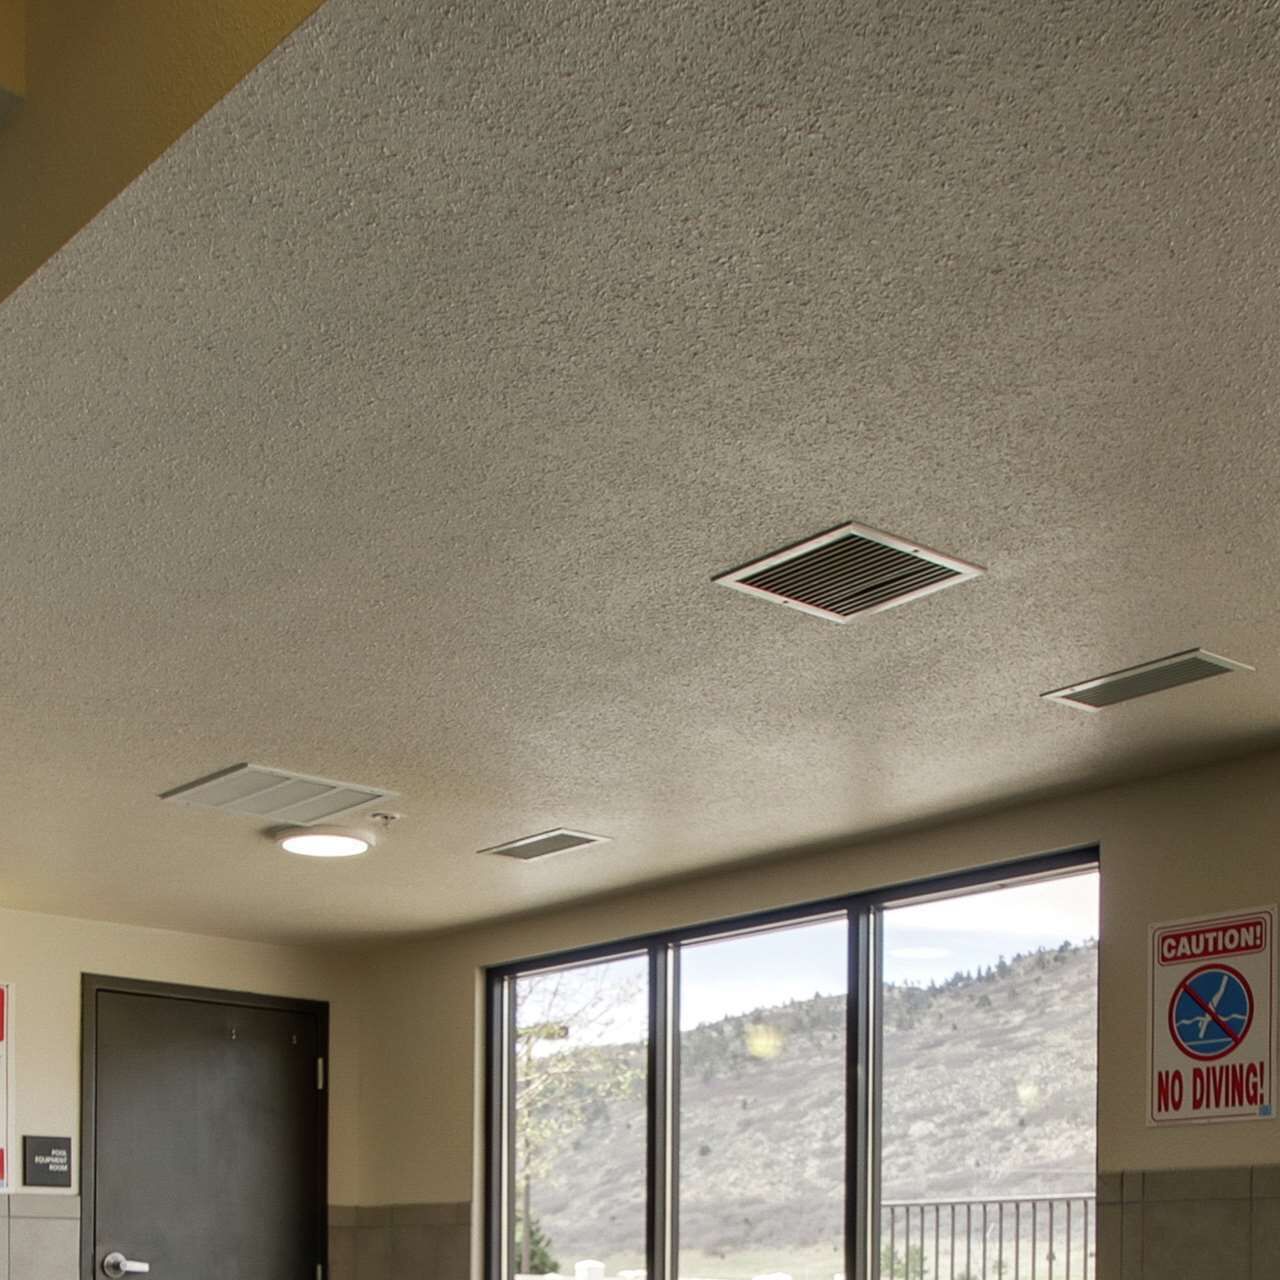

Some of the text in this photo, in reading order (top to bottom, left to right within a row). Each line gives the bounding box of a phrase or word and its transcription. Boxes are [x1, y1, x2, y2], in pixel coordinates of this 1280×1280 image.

[1163, 926, 1261, 959] CAUTION!
[1157, 1061, 1265, 1113] NO DIVING!
